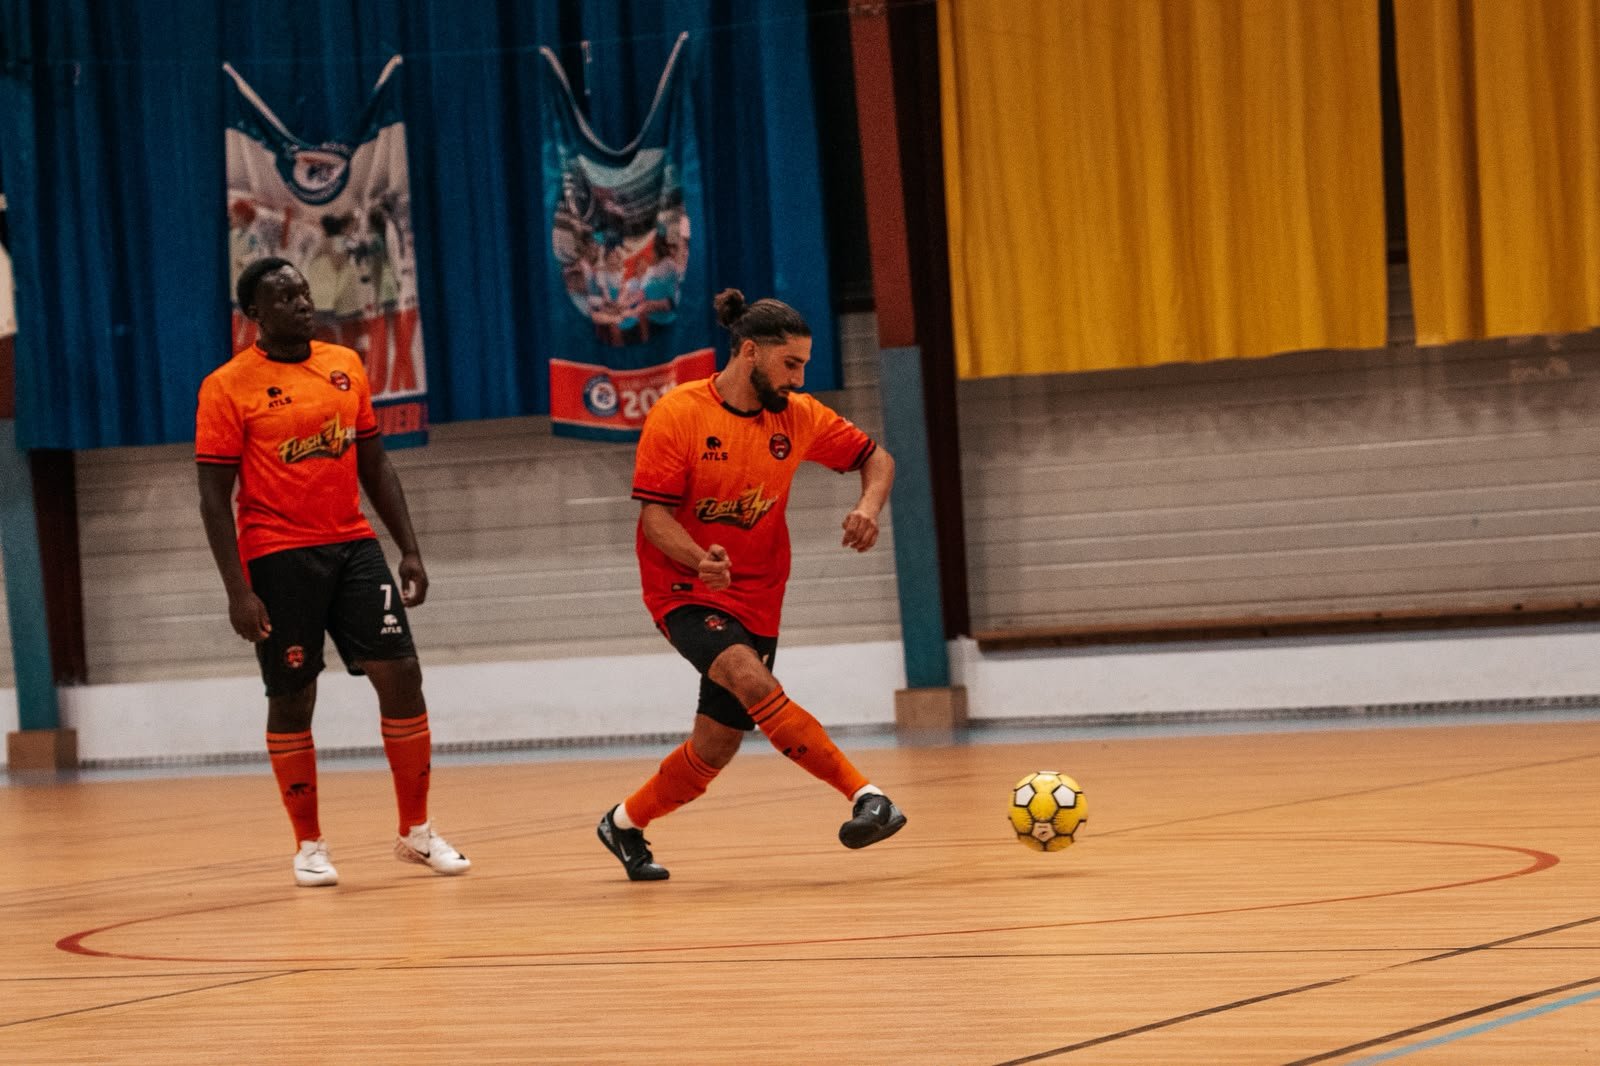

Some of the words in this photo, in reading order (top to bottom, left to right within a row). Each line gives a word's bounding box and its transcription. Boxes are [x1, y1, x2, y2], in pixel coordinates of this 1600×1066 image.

[268, 396, 292, 408] ATLS
[622, 381, 677, 418] 20
[702, 452, 728, 461] ATLS
[380, 584, 392, 610] 7
